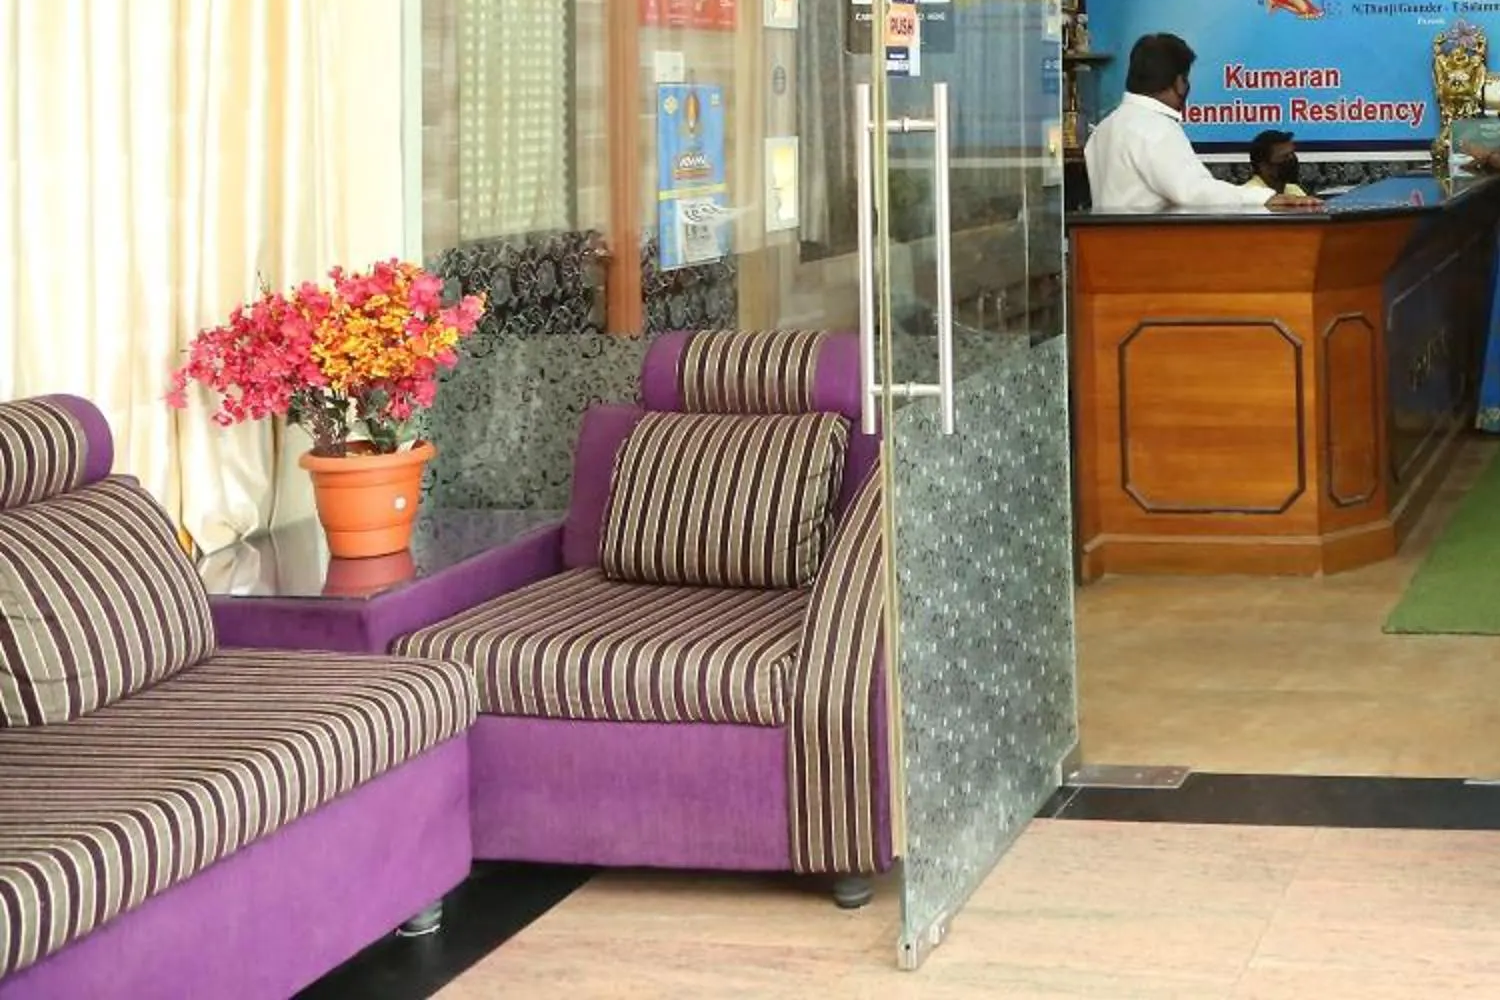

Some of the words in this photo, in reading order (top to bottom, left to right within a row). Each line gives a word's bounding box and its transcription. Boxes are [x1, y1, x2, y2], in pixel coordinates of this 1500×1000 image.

[890, 16, 914, 35] PUSH
[1224, 65, 1341, 88] Kumaran
[1291, 99, 1425, 126] Residency
